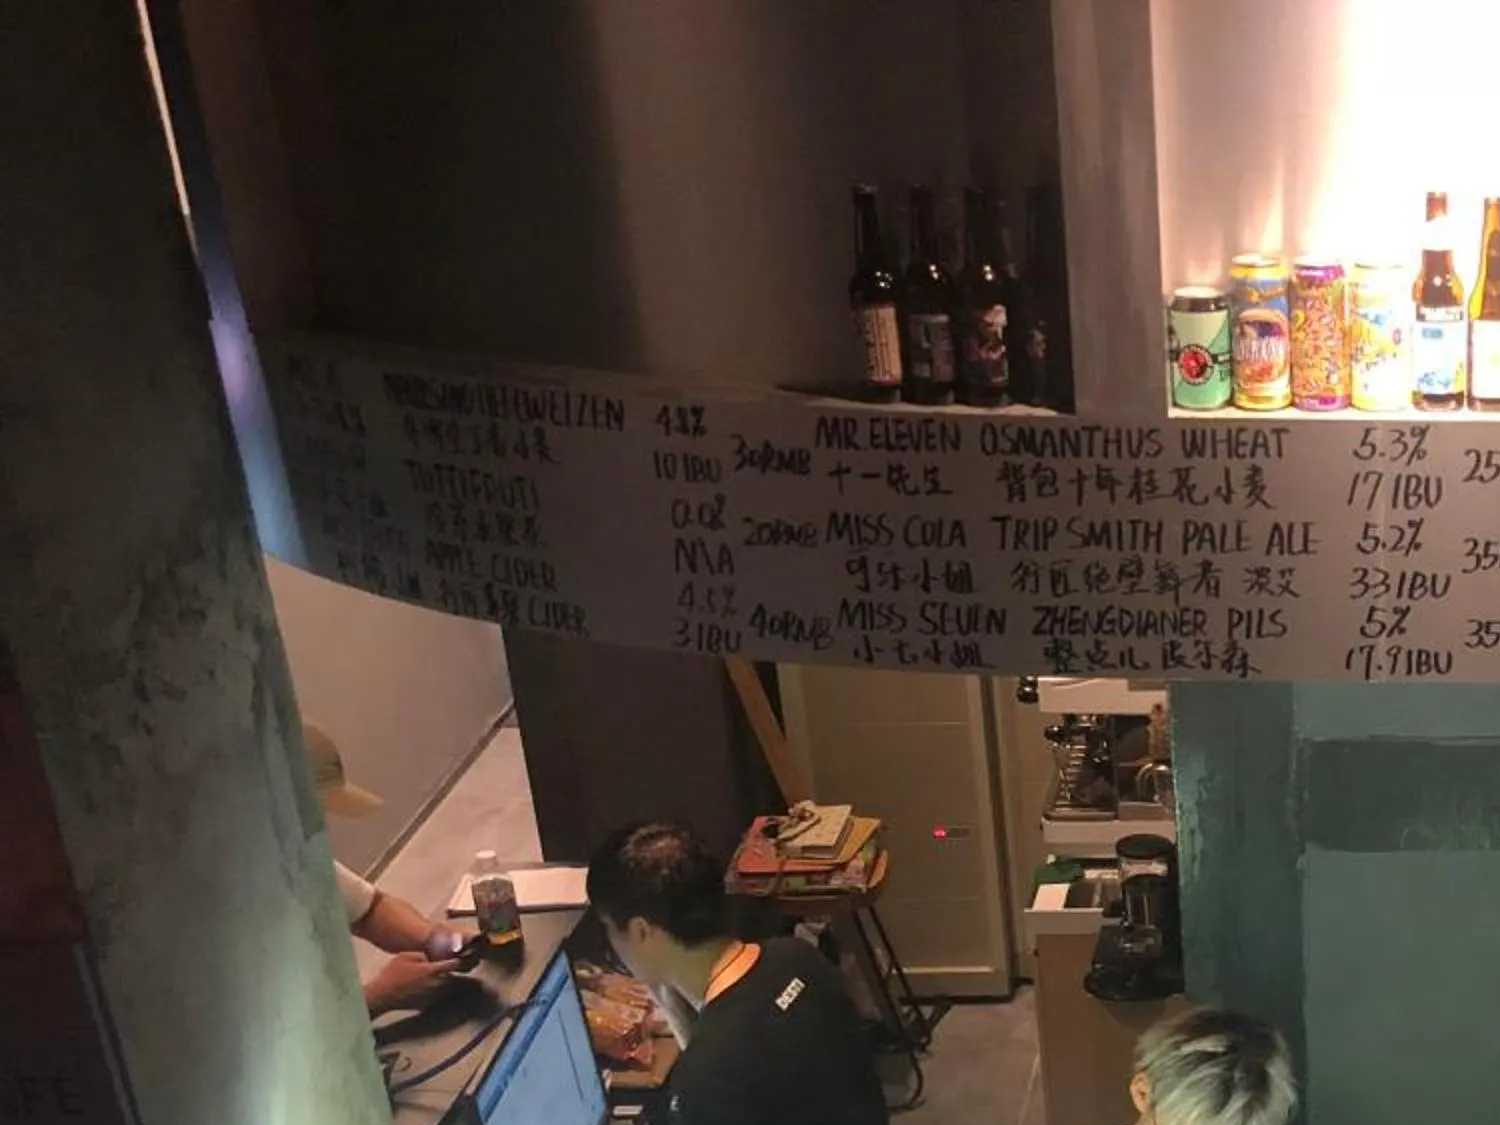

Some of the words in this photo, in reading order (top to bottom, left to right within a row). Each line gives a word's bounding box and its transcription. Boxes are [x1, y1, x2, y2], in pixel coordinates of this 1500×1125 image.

[980, 421, 1164, 459] OSMANTHUS
[1180, 424, 1291, 460] WHEAT
[1351, 424, 1431, 467] 5.3%
[901, 513, 968, 549] COLA
[990, 514, 1059, 553] TRIP
[1065, 516, 1165, 555] SMITH
[1180, 518, 1253, 557] PALE
[1264, 520, 1322, 557] ALE
[1355, 516, 1424, 558] 5.2%
[837, 597, 907, 635] MISS
[1031, 604, 1208, 639] ZHENGDIANER
[1226, 606, 1290, 640] PILS
[1358, 604, 1412, 640] 5%
